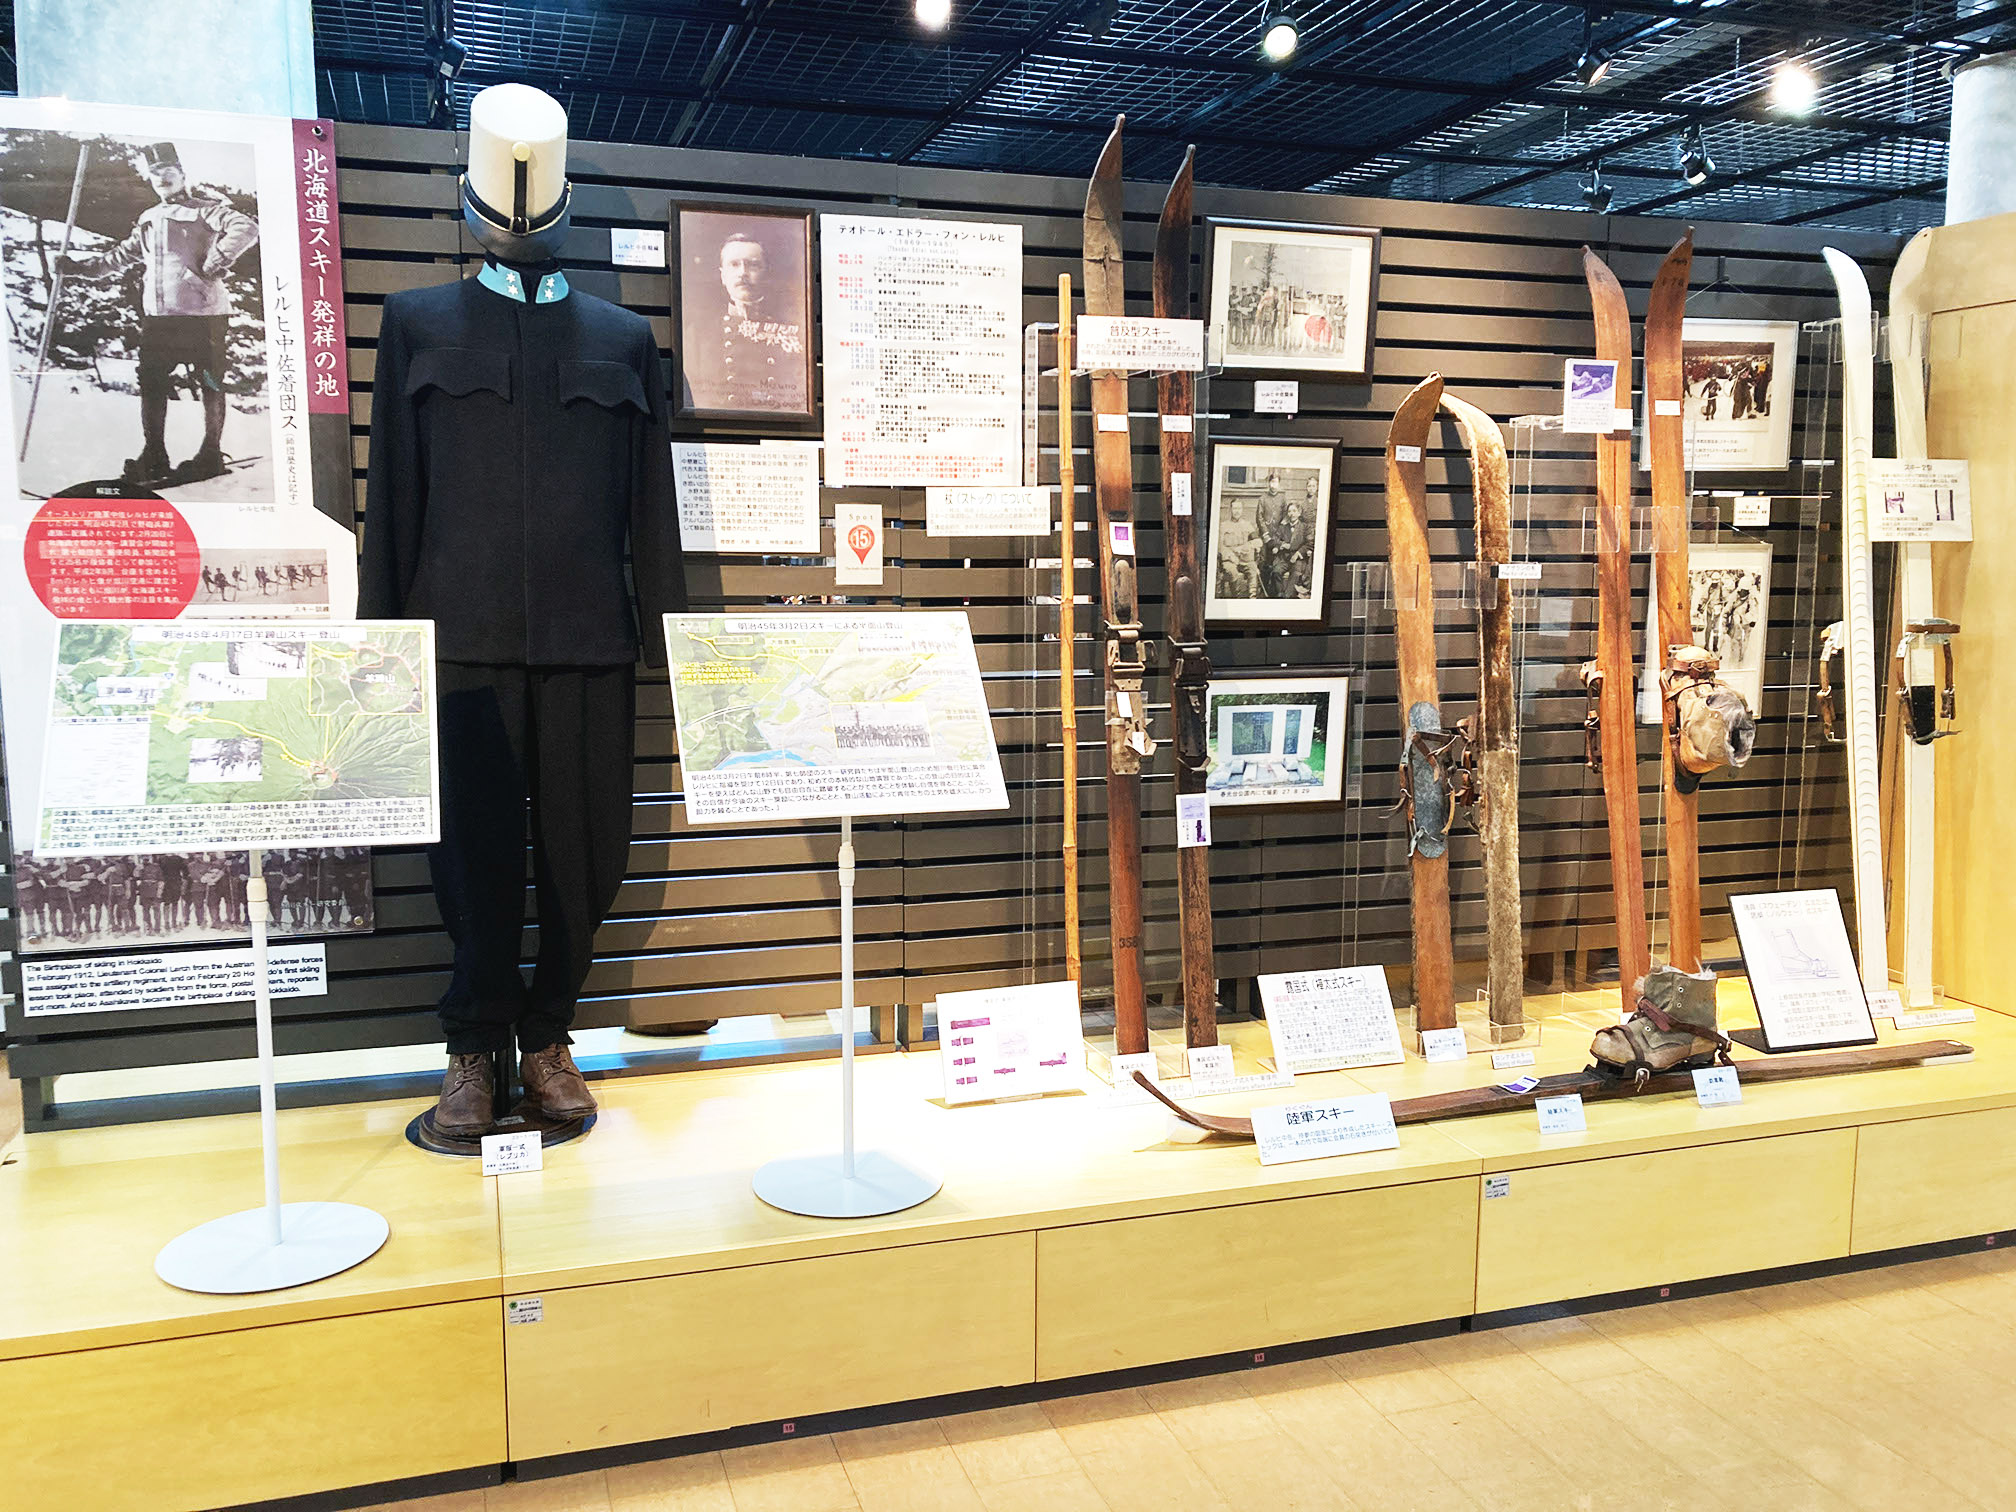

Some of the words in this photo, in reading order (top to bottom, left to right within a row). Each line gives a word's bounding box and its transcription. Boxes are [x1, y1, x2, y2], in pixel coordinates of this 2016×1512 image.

[838, 224, 1006, 243] テオドール・エドラー・フォン・レルヒ
[302, 148, 340, 397] 北海道スキー発祥の地
[1110, 325, 1171, 337] 普及型スキー
[275, 275, 297, 429] レルヒ中佐着団ス
[848, 513, 874, 522] Spot
[854, 529, 869, 546] 15
[161, 630, 340, 639] 明治45年4月17日羊蹄山スキー登山
[37, 973, 72, 982] February
[97, 969, 137, 978] Lieutenant
[225, 961, 255, 969] Austrian
[44, 963, 82, 972] Birthplace
[104, 979, 131, 987] artillery
[197, 972, 230, 980] February
[299, 966, 320, 974] skiing
[146, 985, 175, 993] soldiers
[231, 980, 254, 988] postal
[287, 975, 319, 983] reporters
[99, 998, 139, 1006] Asahikawa
[187, 992, 223, 1000] birthplace
[234, 989, 256, 997] skiing
[1286, 1107, 1355, 1126] 陸軍スキー
